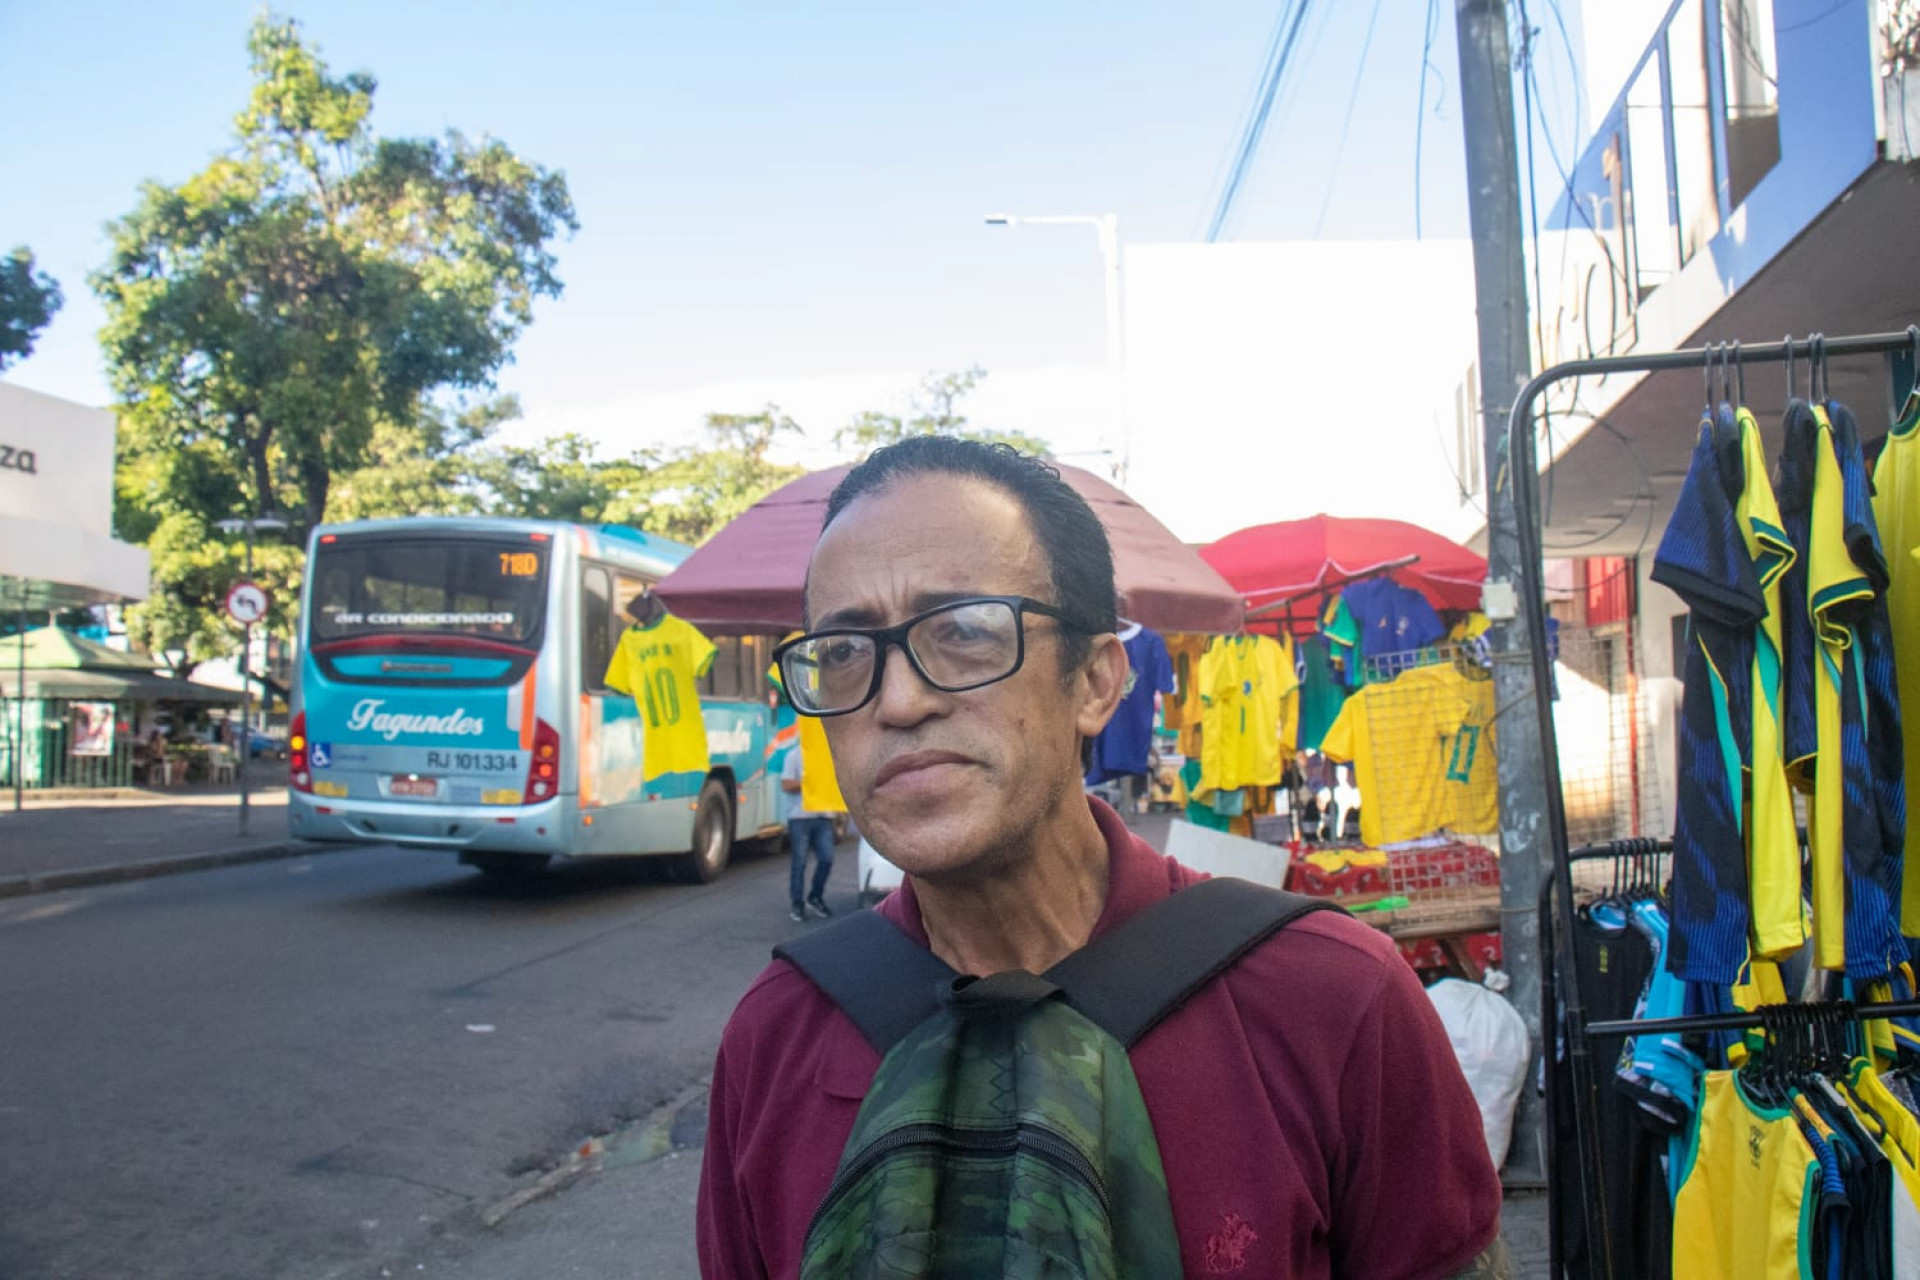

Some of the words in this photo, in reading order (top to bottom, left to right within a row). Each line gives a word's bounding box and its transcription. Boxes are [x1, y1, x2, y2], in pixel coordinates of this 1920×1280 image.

[644, 667, 681, 728] 10
[347, 699, 484, 741] Fagundes
[427, 753, 450, 768] RJ
